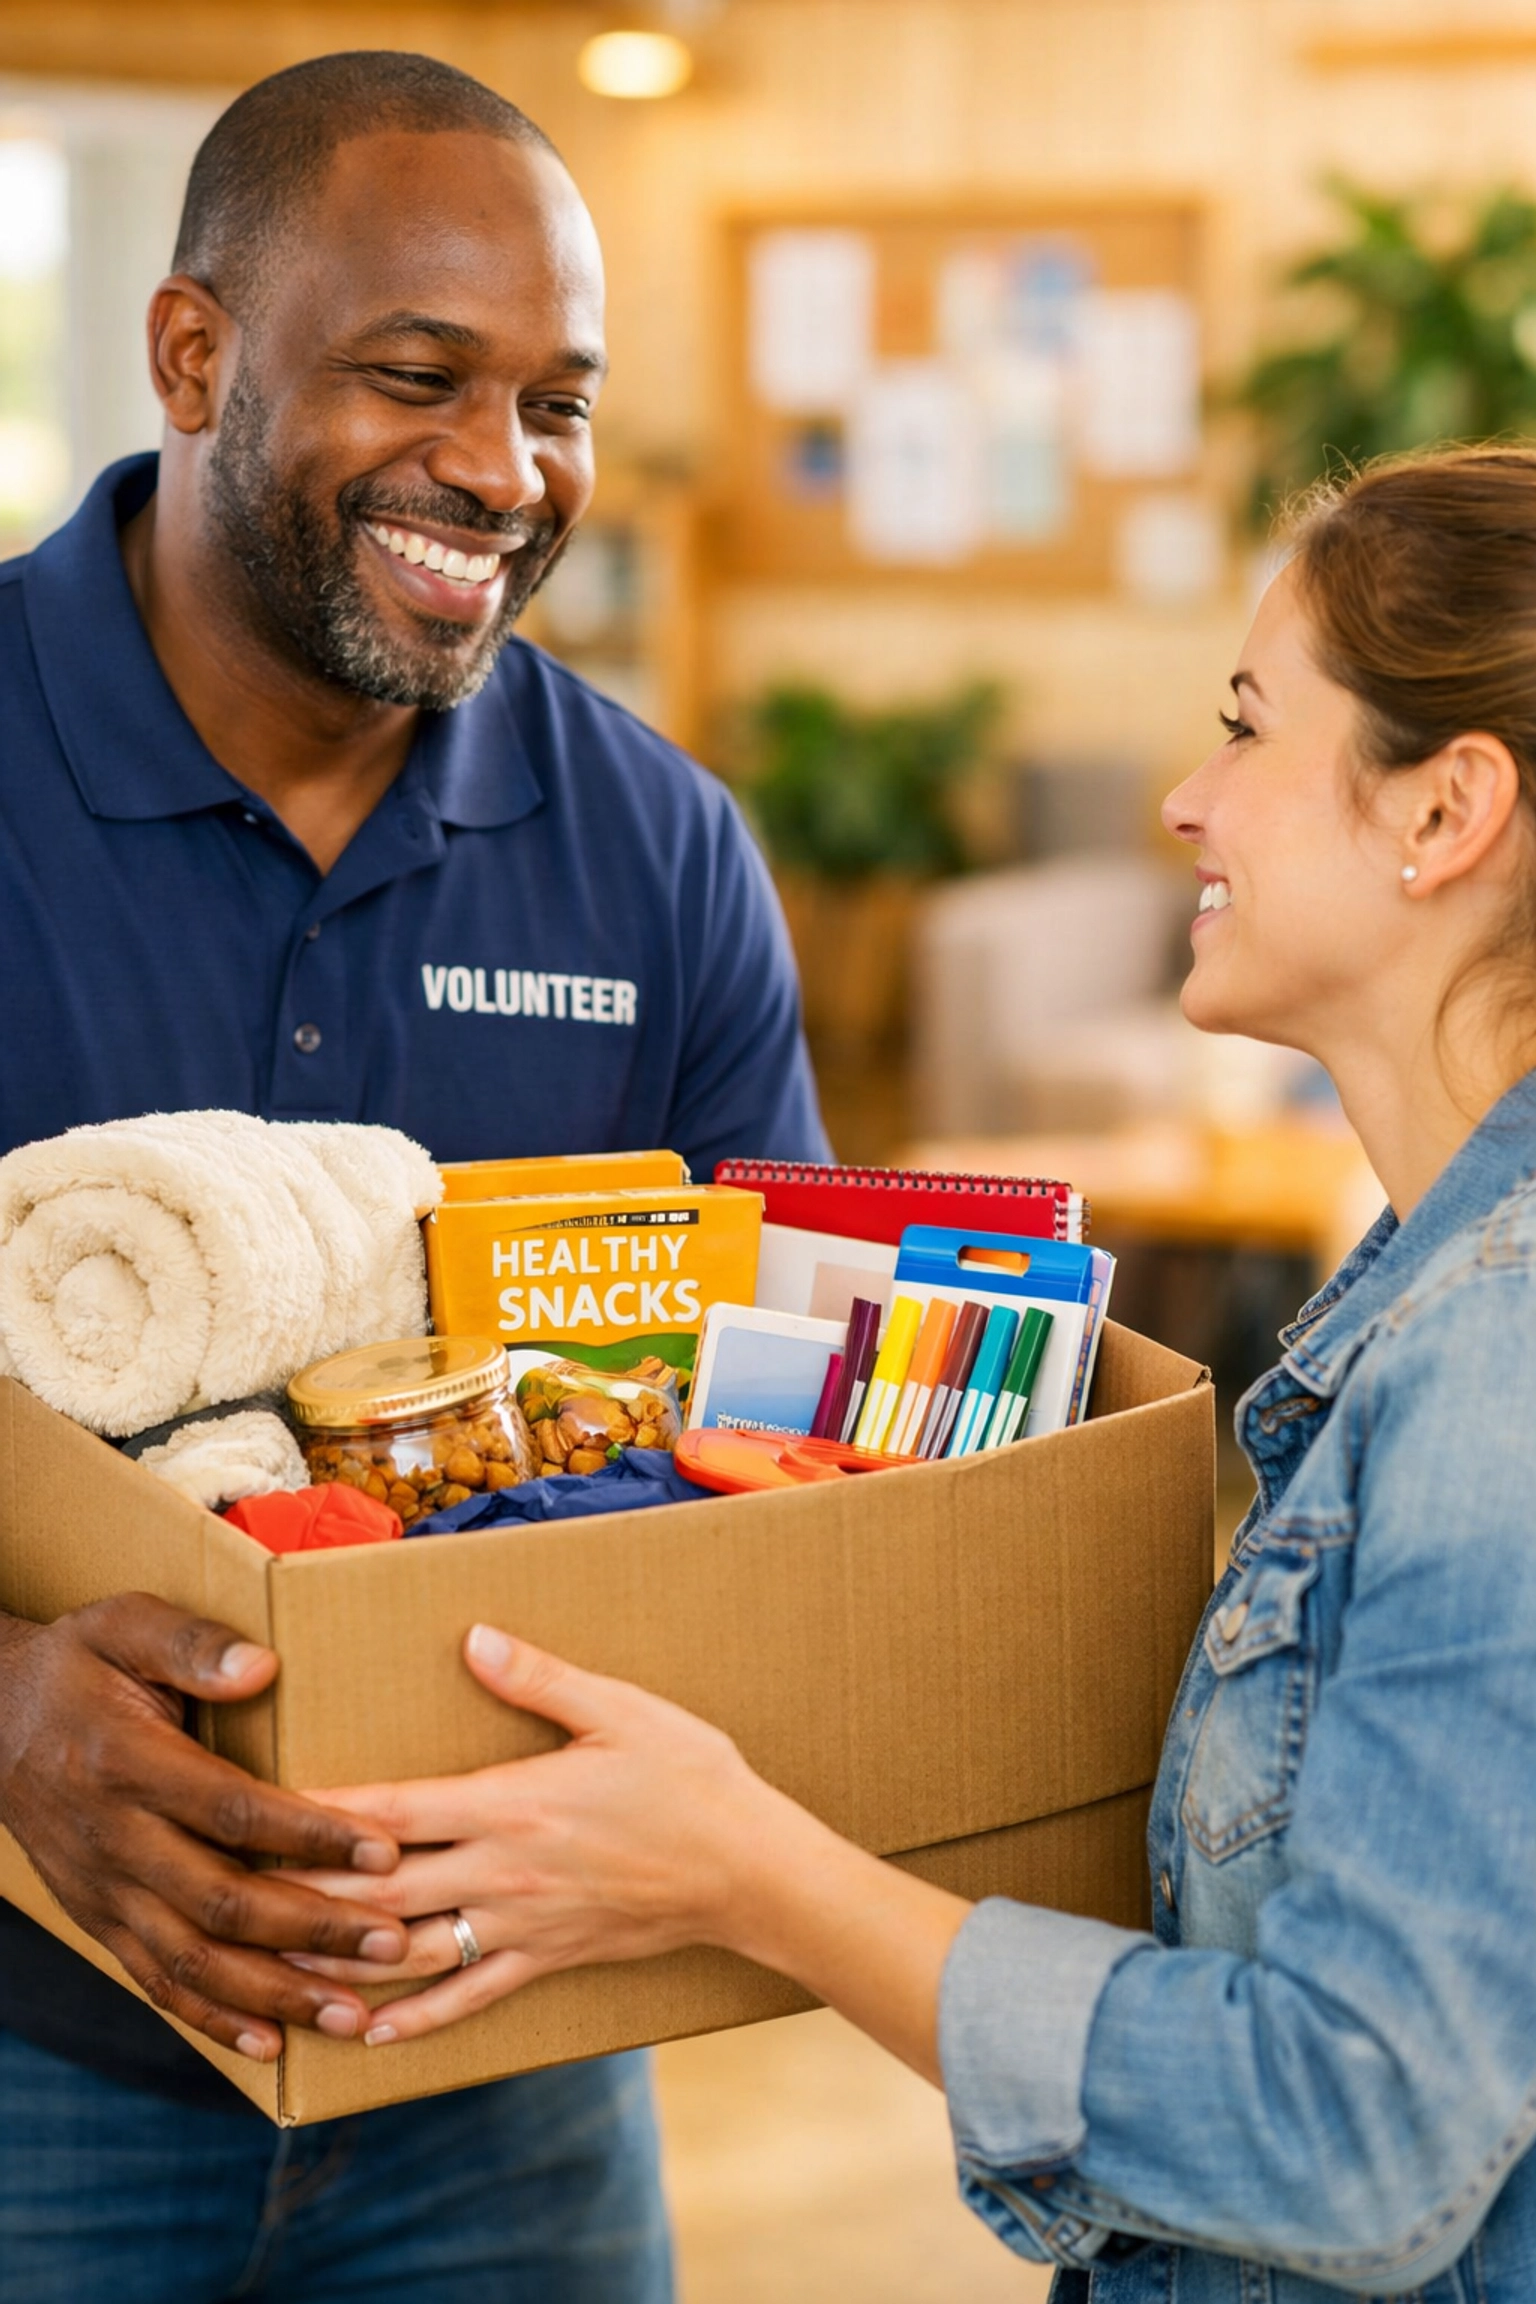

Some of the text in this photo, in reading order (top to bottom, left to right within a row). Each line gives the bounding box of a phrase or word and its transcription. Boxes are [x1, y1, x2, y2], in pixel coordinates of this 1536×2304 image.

[421, 963, 638, 1026] VOLUNTEER
[491, 1233, 688, 1278] HEALTHY
[497, 1278, 701, 1332] SNACKS
